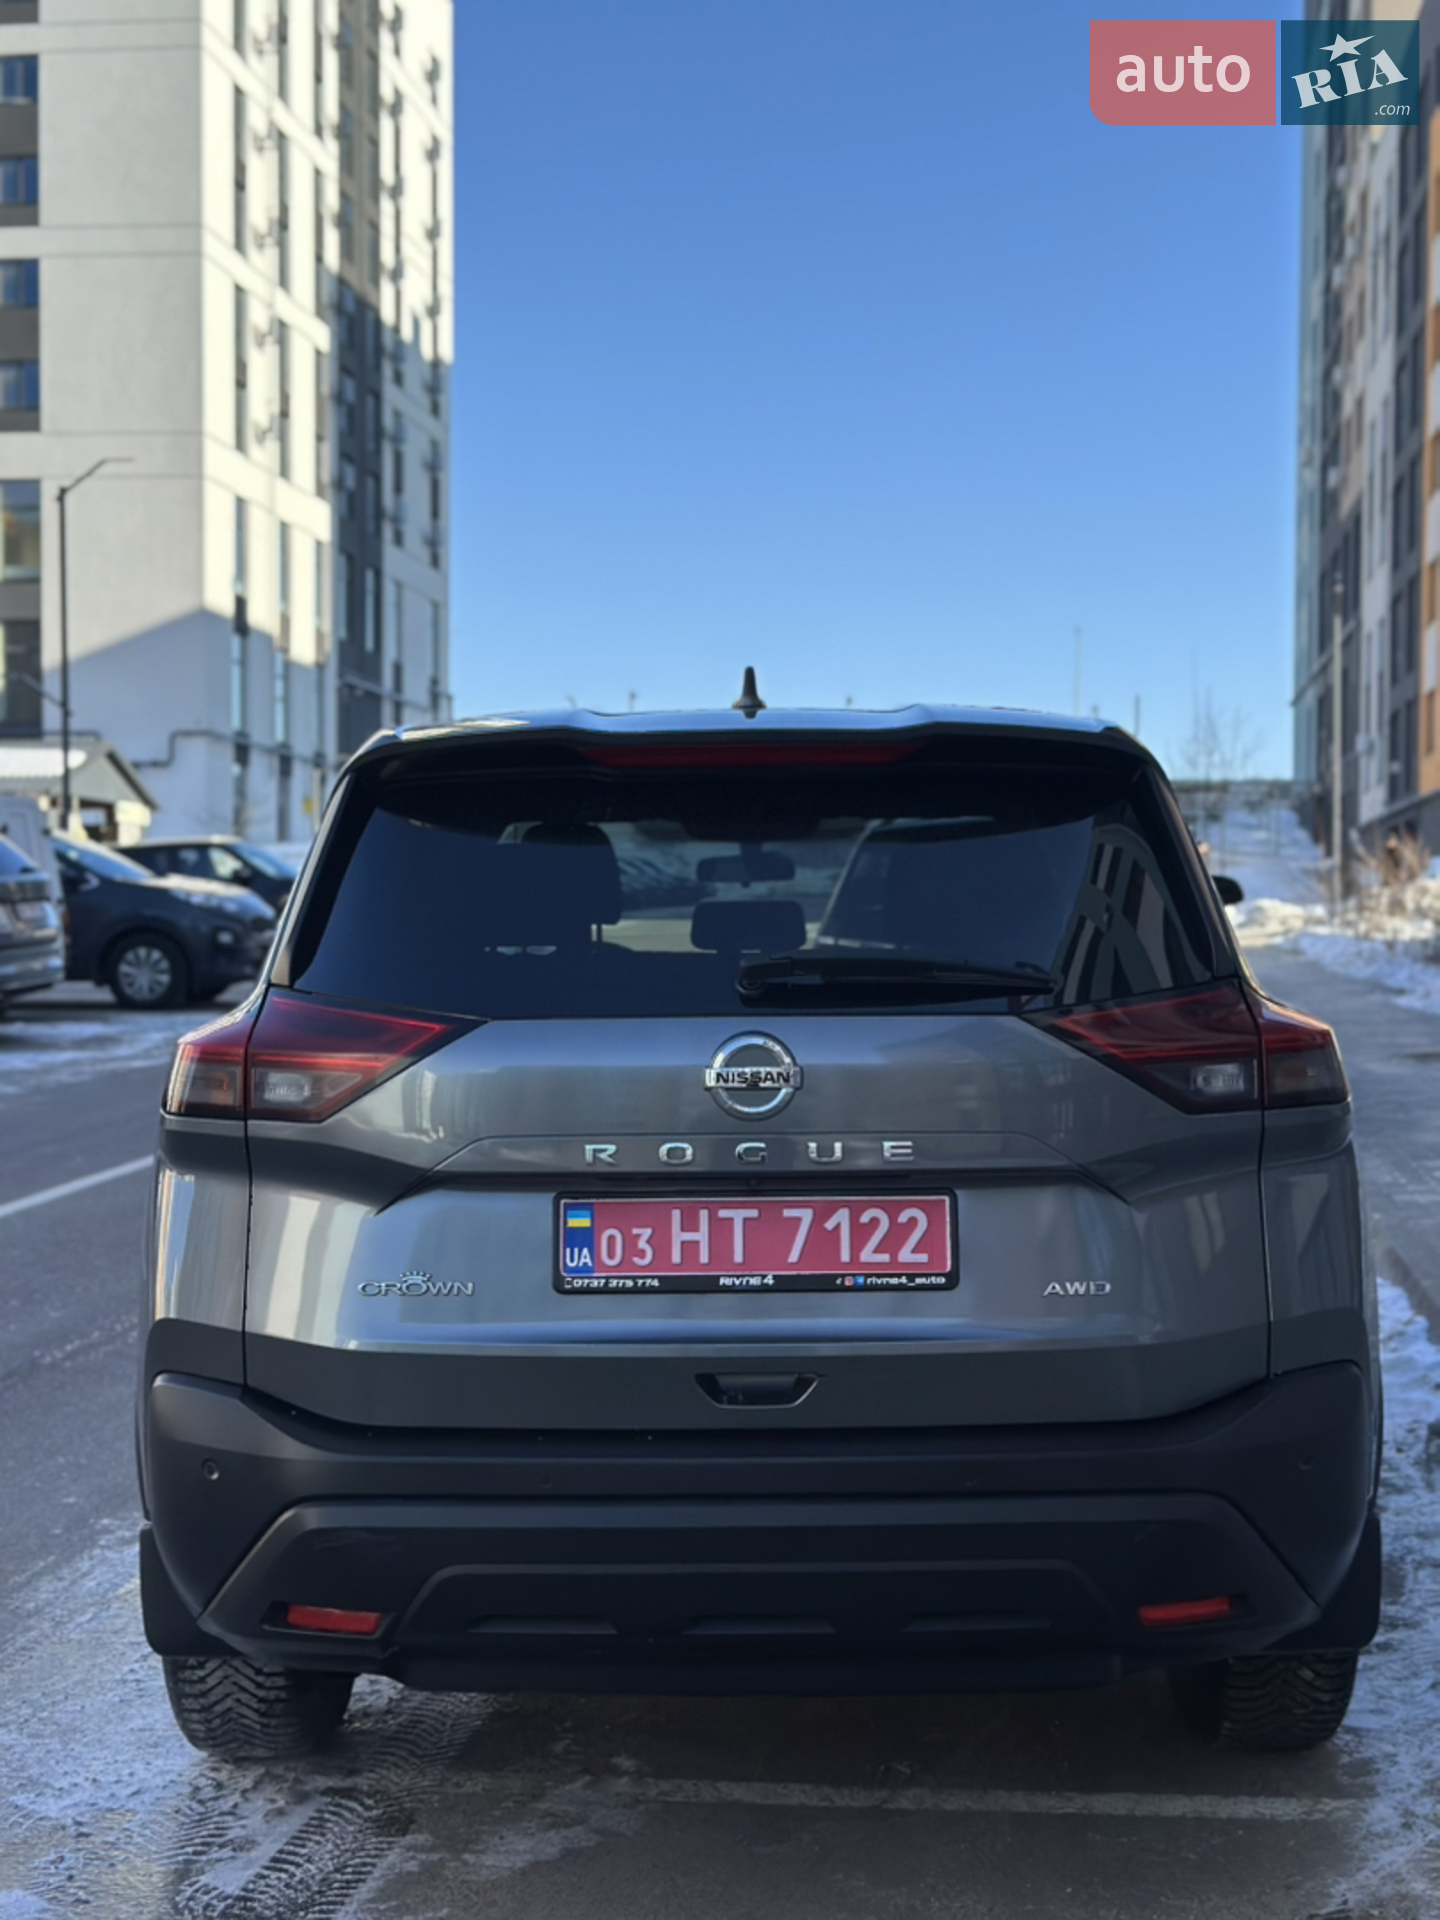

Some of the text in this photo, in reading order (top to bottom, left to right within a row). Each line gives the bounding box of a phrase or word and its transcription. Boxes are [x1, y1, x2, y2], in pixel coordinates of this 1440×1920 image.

[716, 1071, 790, 1084] NISSAN
[584, 1141, 914, 1165] ROGUE
[565, 1208, 929, 1266] UA 03 HT 7122
[357, 1276, 474, 1297] CROWN
[1042, 1281, 1111, 1297] AWD
